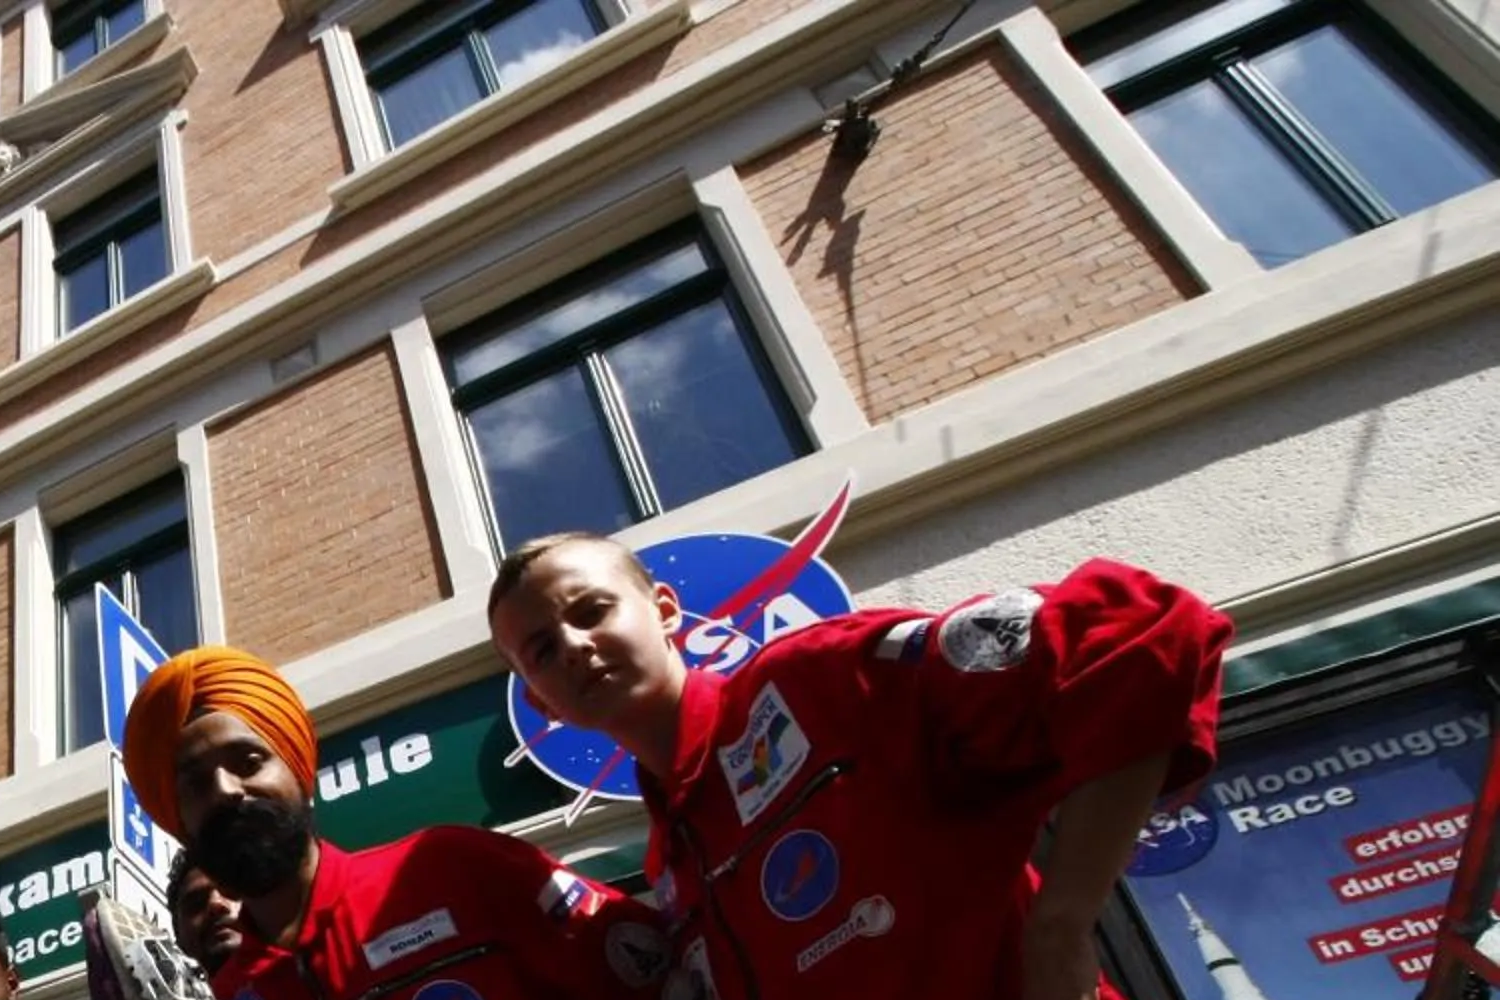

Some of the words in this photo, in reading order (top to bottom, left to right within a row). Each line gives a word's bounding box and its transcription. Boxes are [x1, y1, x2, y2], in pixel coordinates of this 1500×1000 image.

[685, 592, 824, 671] SA
[317, 732, 433, 801] ule
[1213, 712, 1491, 806] Moonbuggy
[1228, 786, 1355, 833] Race
[1355, 813, 1470, 857] erfolgr
[1340, 849, 1461, 898] durchs
[1317, 939, 1355, 958] in
[1360, 914, 1444, 947] Schu
